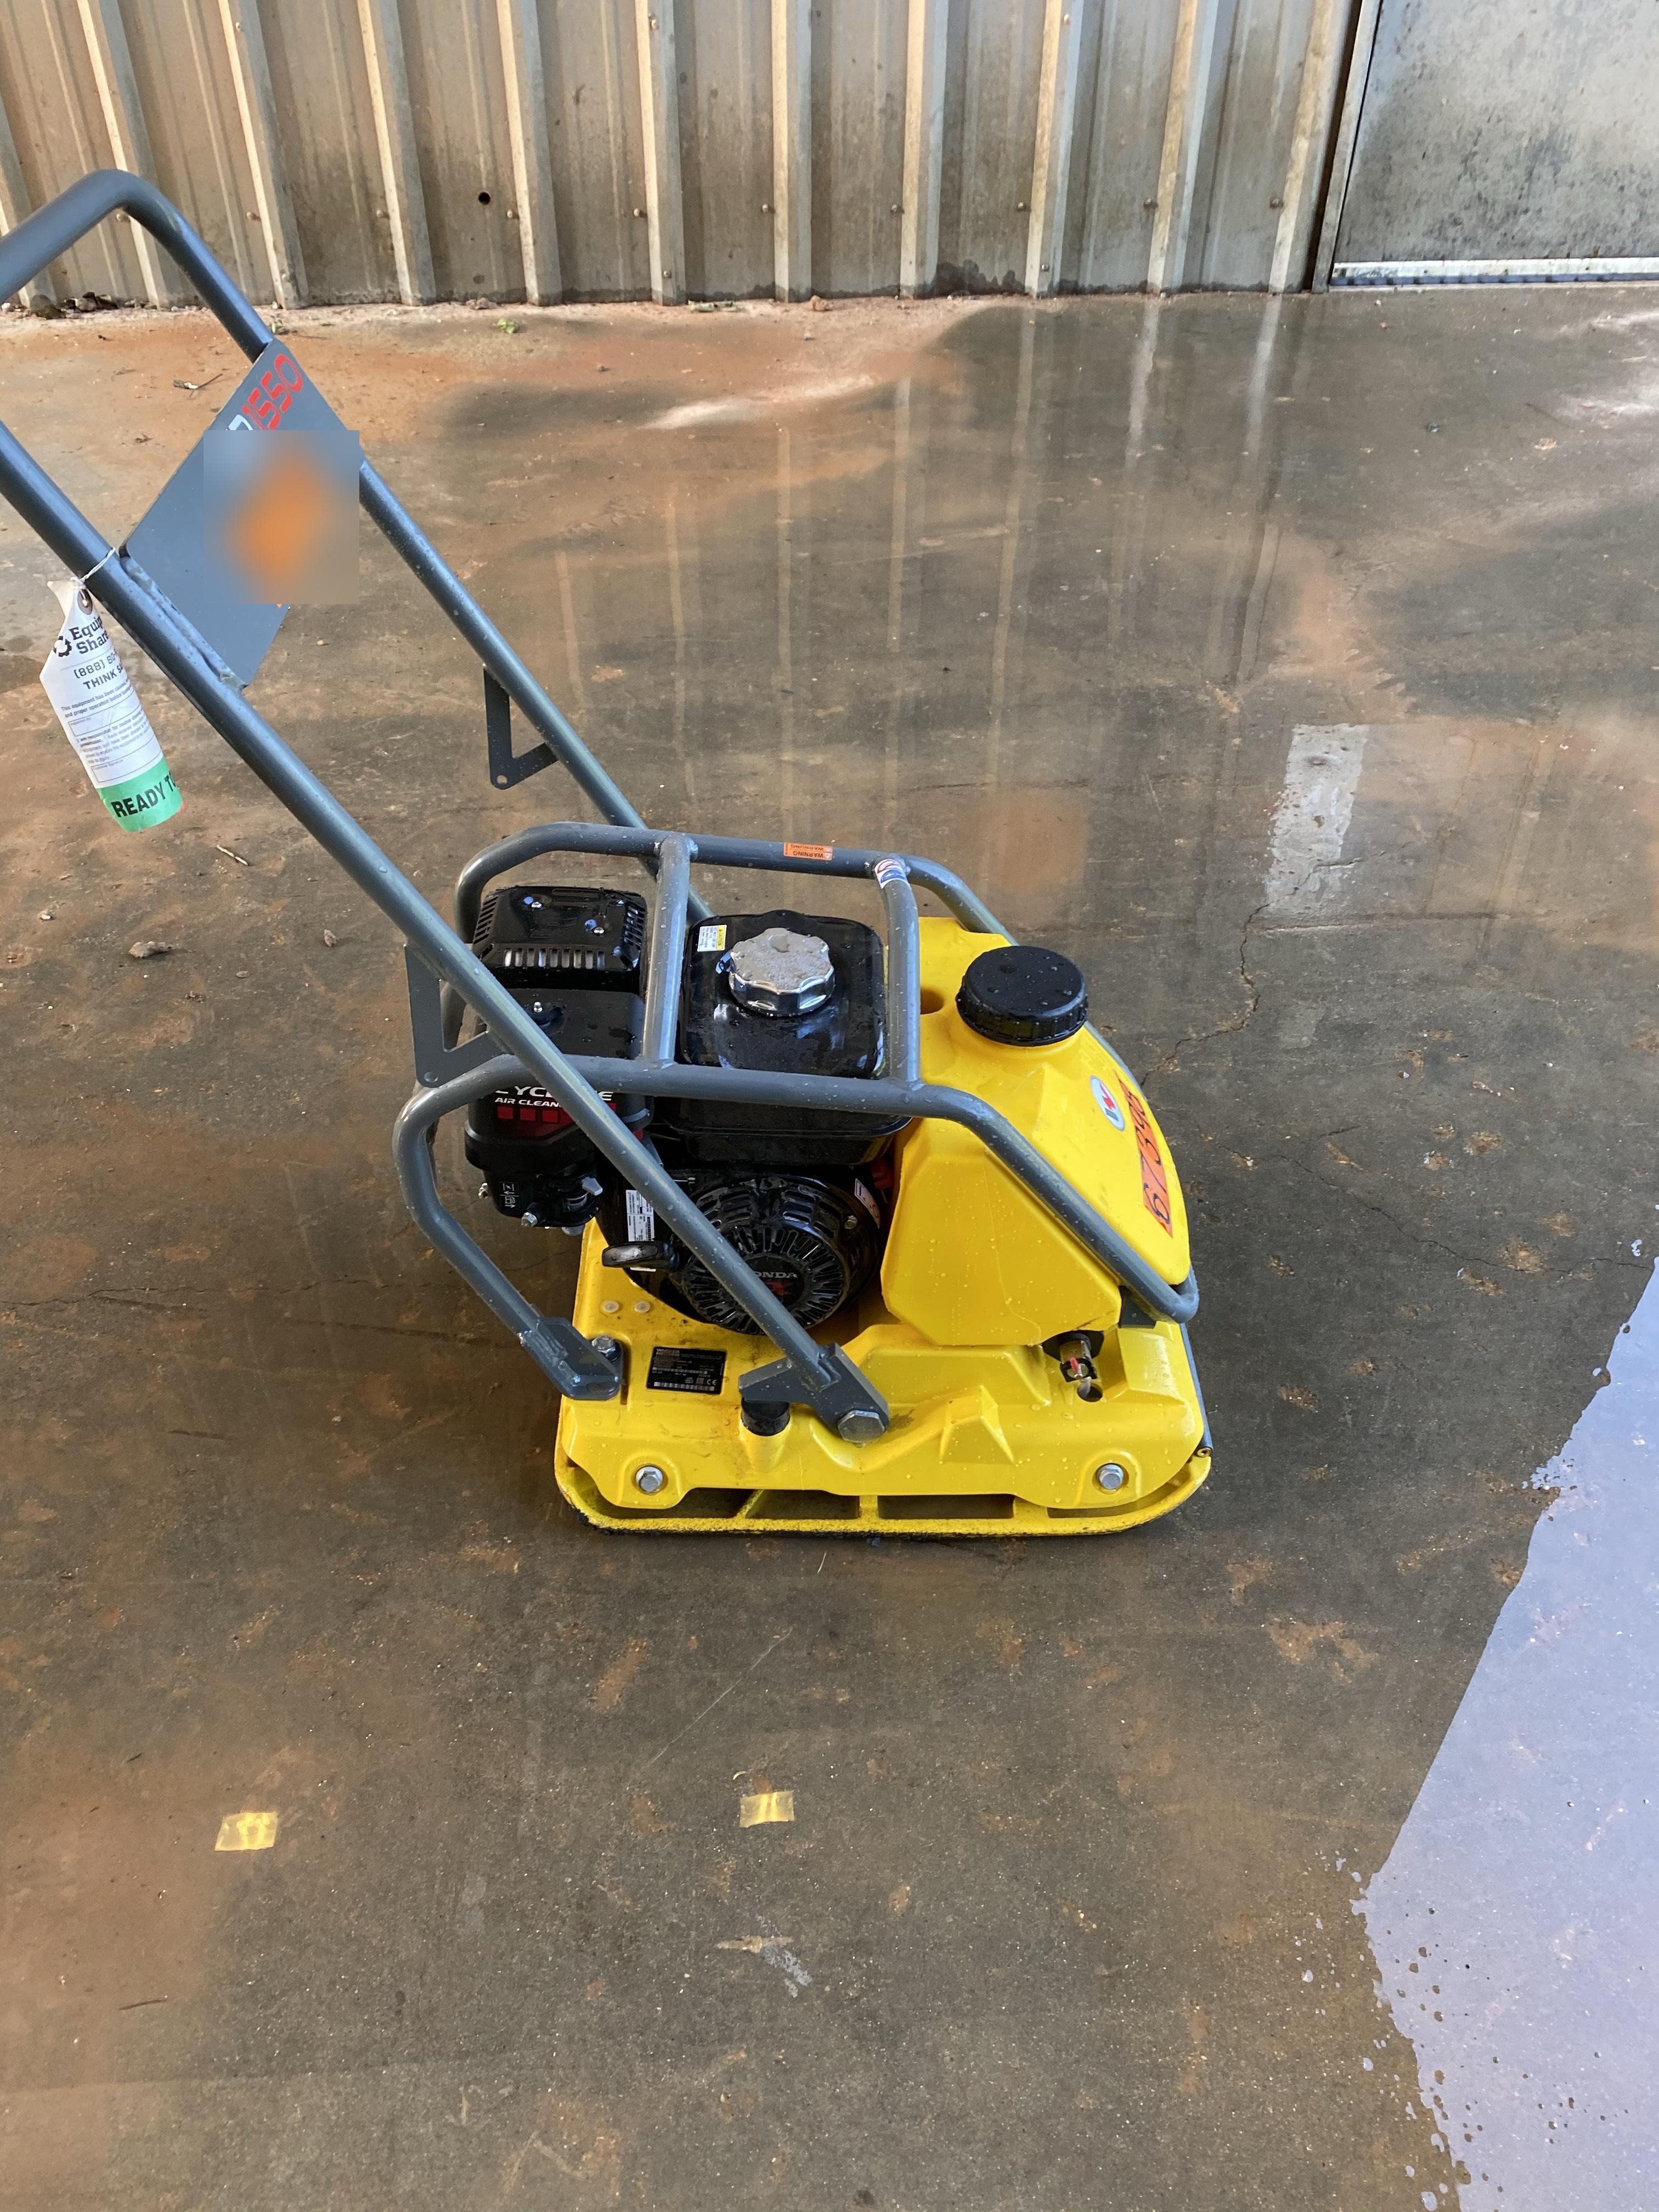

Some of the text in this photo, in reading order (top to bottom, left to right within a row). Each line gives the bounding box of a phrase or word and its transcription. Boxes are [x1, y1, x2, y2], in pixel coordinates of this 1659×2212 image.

[74, 660, 105, 679] (888)
[83, 669, 117, 689] THINK
[111, 782, 166, 817] READY
[518, 1099, 562, 1108] CLEAN
